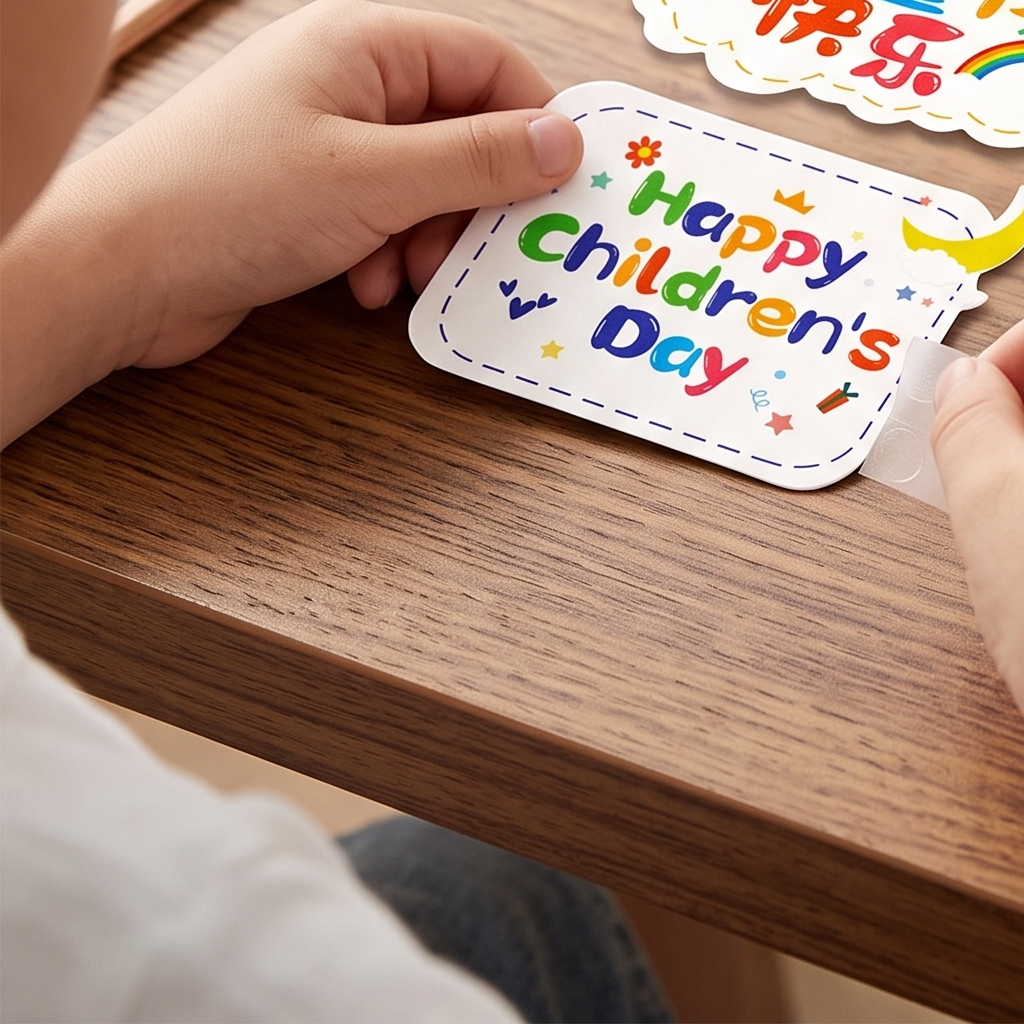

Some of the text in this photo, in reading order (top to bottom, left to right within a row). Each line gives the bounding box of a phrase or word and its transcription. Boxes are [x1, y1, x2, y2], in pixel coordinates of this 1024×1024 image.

[627, 169, 868, 290] Happy
[518, 212, 901, 372] Children's
[590, 305, 750, 397] Day
